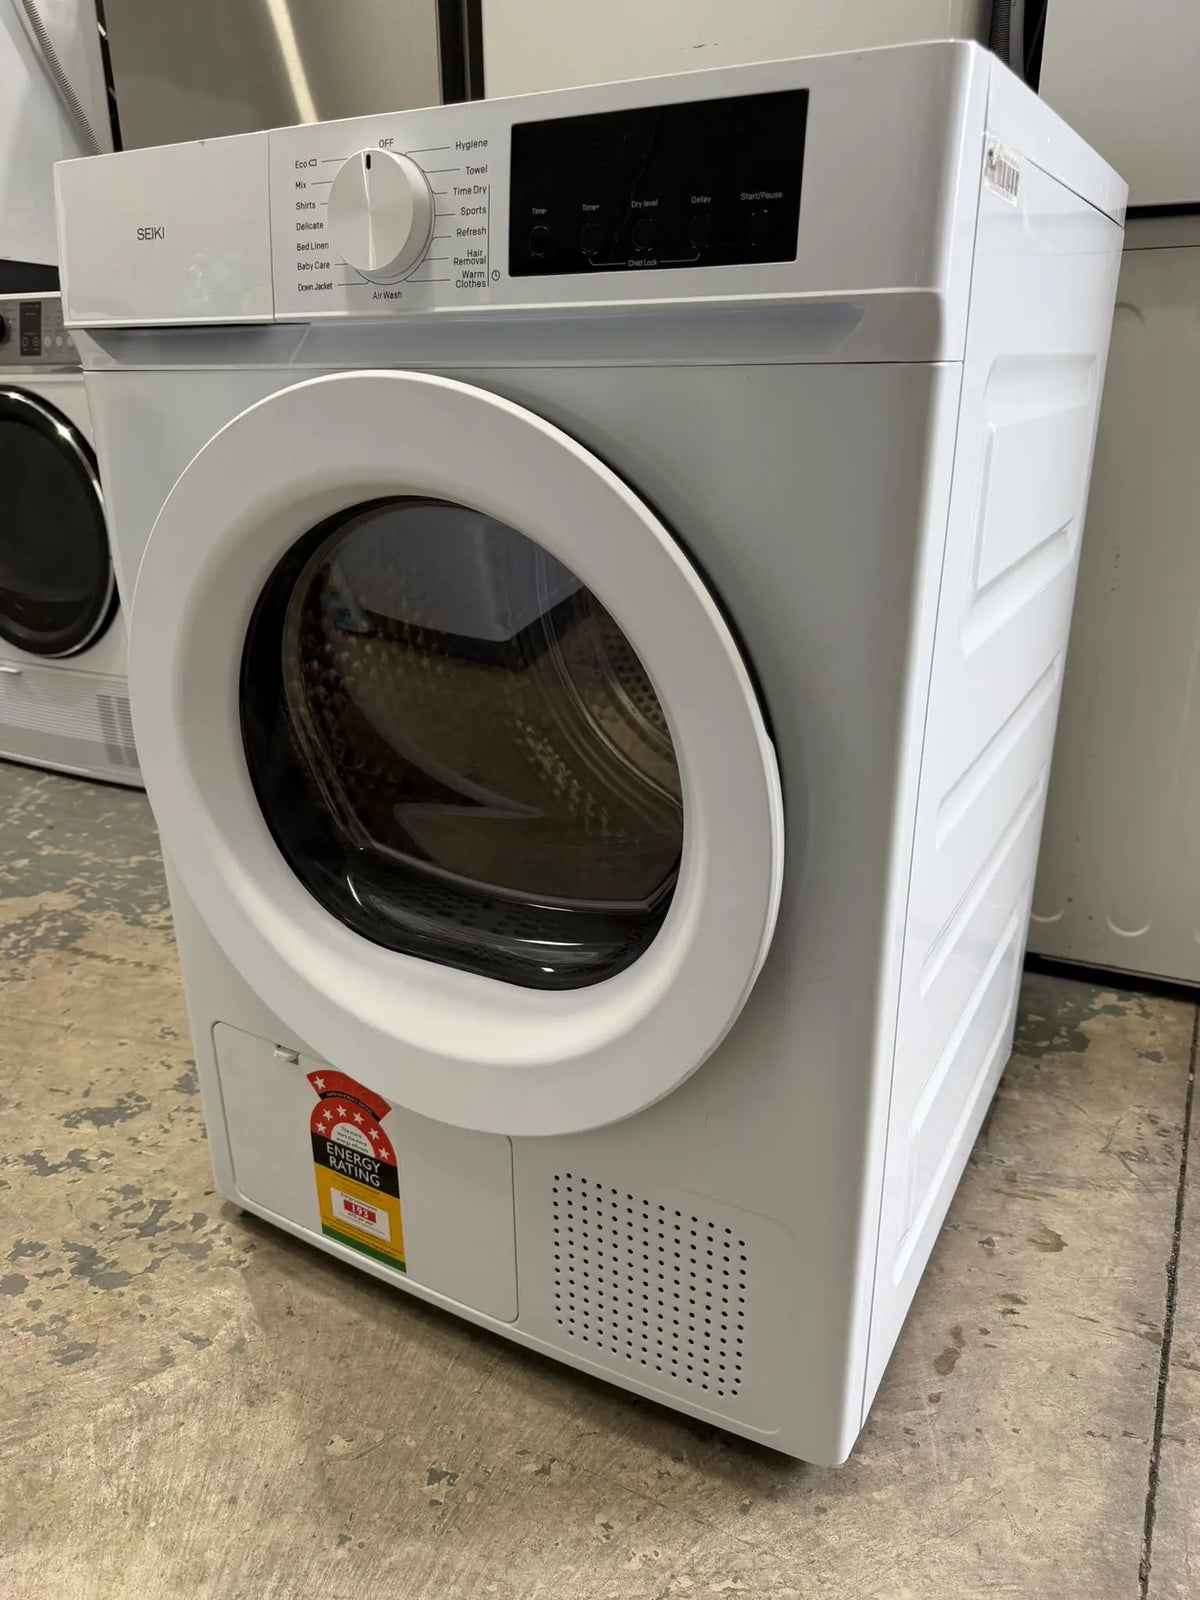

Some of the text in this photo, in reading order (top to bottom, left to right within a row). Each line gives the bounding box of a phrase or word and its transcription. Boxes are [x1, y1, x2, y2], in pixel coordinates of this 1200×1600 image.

[379, 138, 394, 148] OFF
[455, 139, 488, 150] Hygiene
[295, 160, 308, 169] Eco
[466, 164, 488, 175] Towel
[295, 181, 307, 190] Mix
[453, 186, 487, 197] Time Dry
[740, 190, 783, 201] Start/Pause
[631, 199, 658, 209] Dry level
[691, 194, 712, 205] Delay
[295, 201, 316, 210] Shirts
[460, 206, 487, 217] Sports
[296, 221, 324, 231] Delicate
[136, 226, 165, 241] SEIKI
[456, 227, 487, 237] Refresh
[296, 241, 329, 251] Bed Linen
[467, 249, 483, 258] Hair
[453, 256, 486, 267] Removal
[628, 258, 658, 268] Child Lock
[297, 261, 330, 273] Baby Care
[461, 270, 485, 279] Warm
[298, 282, 333, 292] Down Jacket
[455, 279, 486, 289] Clothes
[372, 291, 402, 300] Air Wash
[326, 1141, 381, 1174] ENERGY
[329, 1155, 381, 1188] RATING
[351, 1202, 370, 1220] 193
